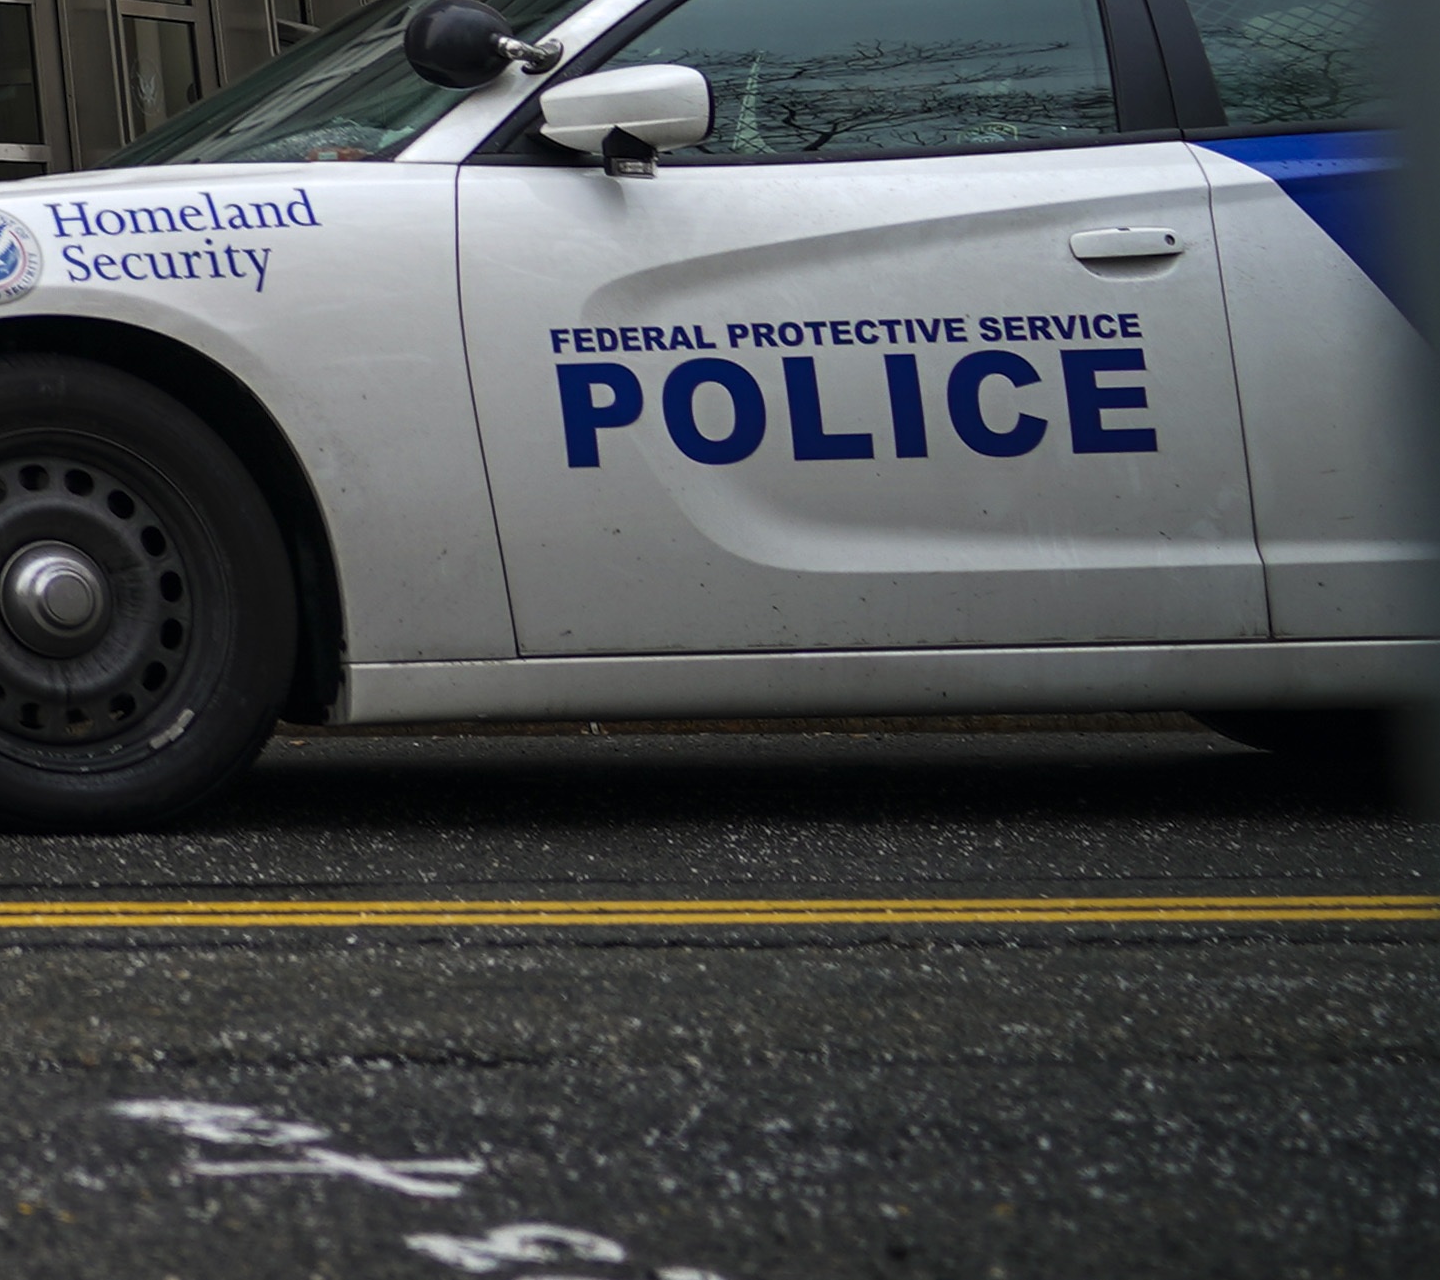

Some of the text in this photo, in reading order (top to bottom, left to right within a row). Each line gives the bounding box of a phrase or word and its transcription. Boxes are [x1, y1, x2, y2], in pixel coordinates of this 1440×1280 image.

[44, 187, 322, 238] Homeland
[62, 238, 271, 292] Security
[550, 313, 1143, 353] FEDERAL PROTECTIVE SERVICE
[555, 348, 1159, 469] POLICE
